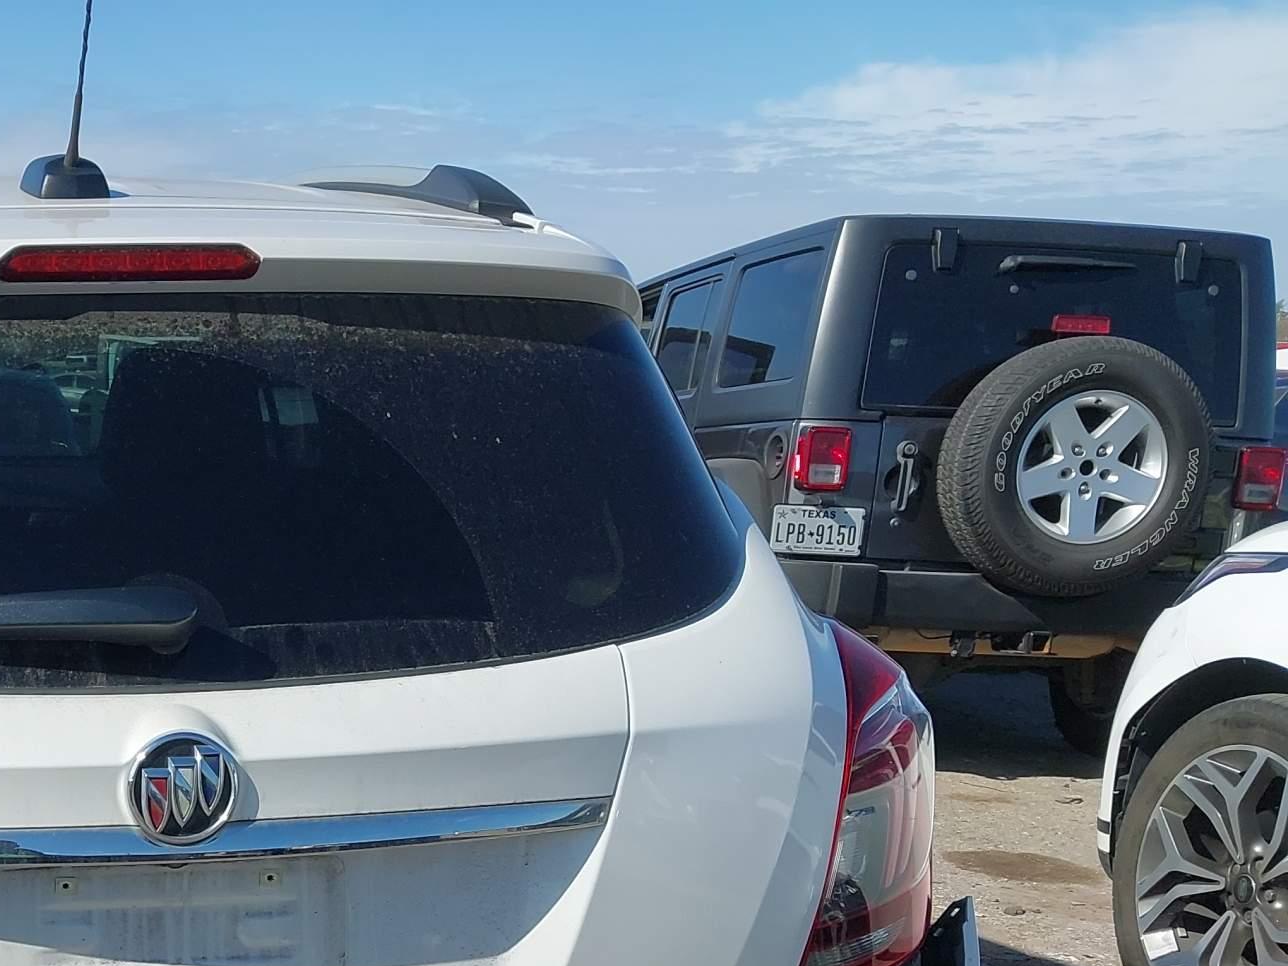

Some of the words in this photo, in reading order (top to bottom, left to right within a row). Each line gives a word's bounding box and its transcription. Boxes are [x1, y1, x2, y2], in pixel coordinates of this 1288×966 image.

[994, 363, 1106, 492] GOODYEAR
[802, 509, 837, 519] TEXAS
[1093, 448, 1200, 570] WRANGLER
